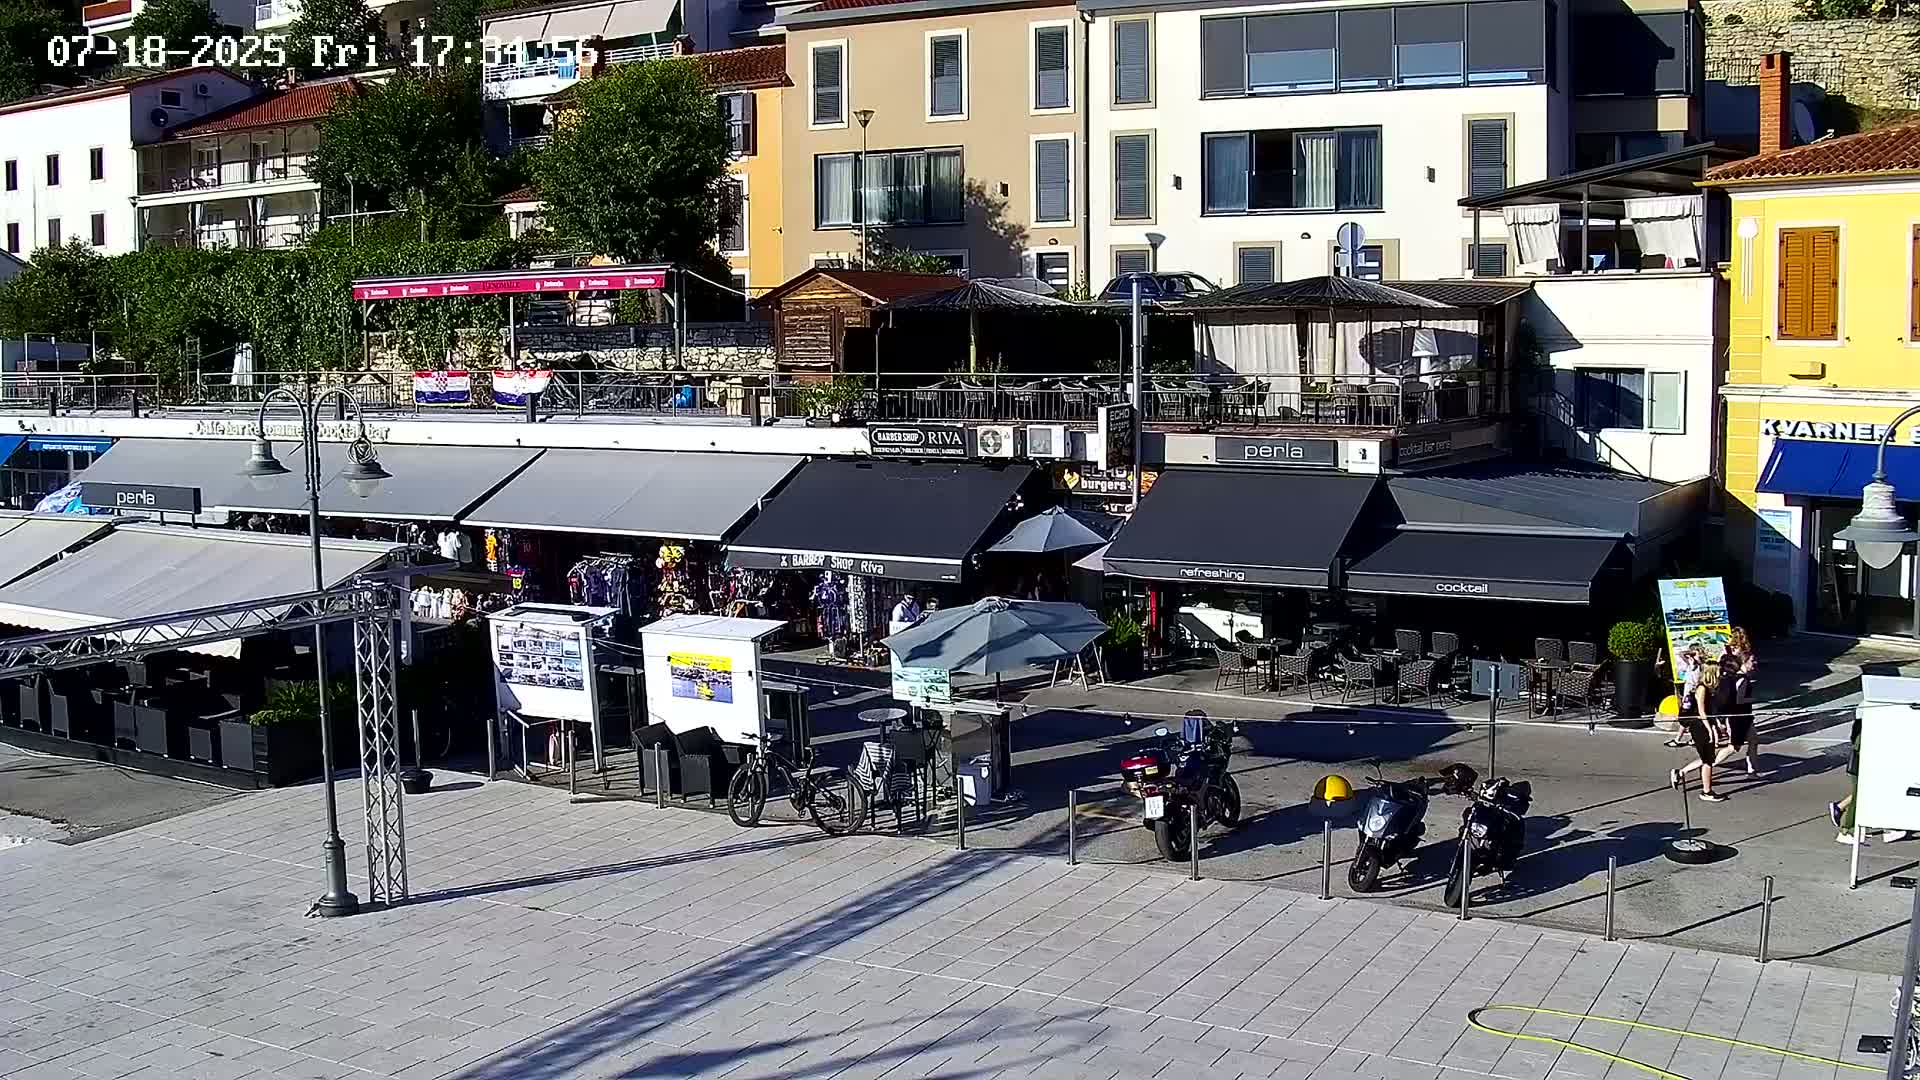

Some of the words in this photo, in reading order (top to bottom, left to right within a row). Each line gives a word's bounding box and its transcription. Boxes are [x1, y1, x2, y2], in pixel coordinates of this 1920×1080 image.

[1110, 408, 1130, 420] ECHO
[927, 431, 962, 445] RIVA
[1244, 442, 1304, 460] perla
[1081, 478, 1127, 492] burgers
[116, 489, 155, 506] perla
[792, 554, 825, 568] BARBER
[830, 555, 854, 571] SHOP
[860, 560, 885, 575] Riva
[1180, 567, 1245, 581] refreshing
[1435, 582, 1488, 593] cocktail
